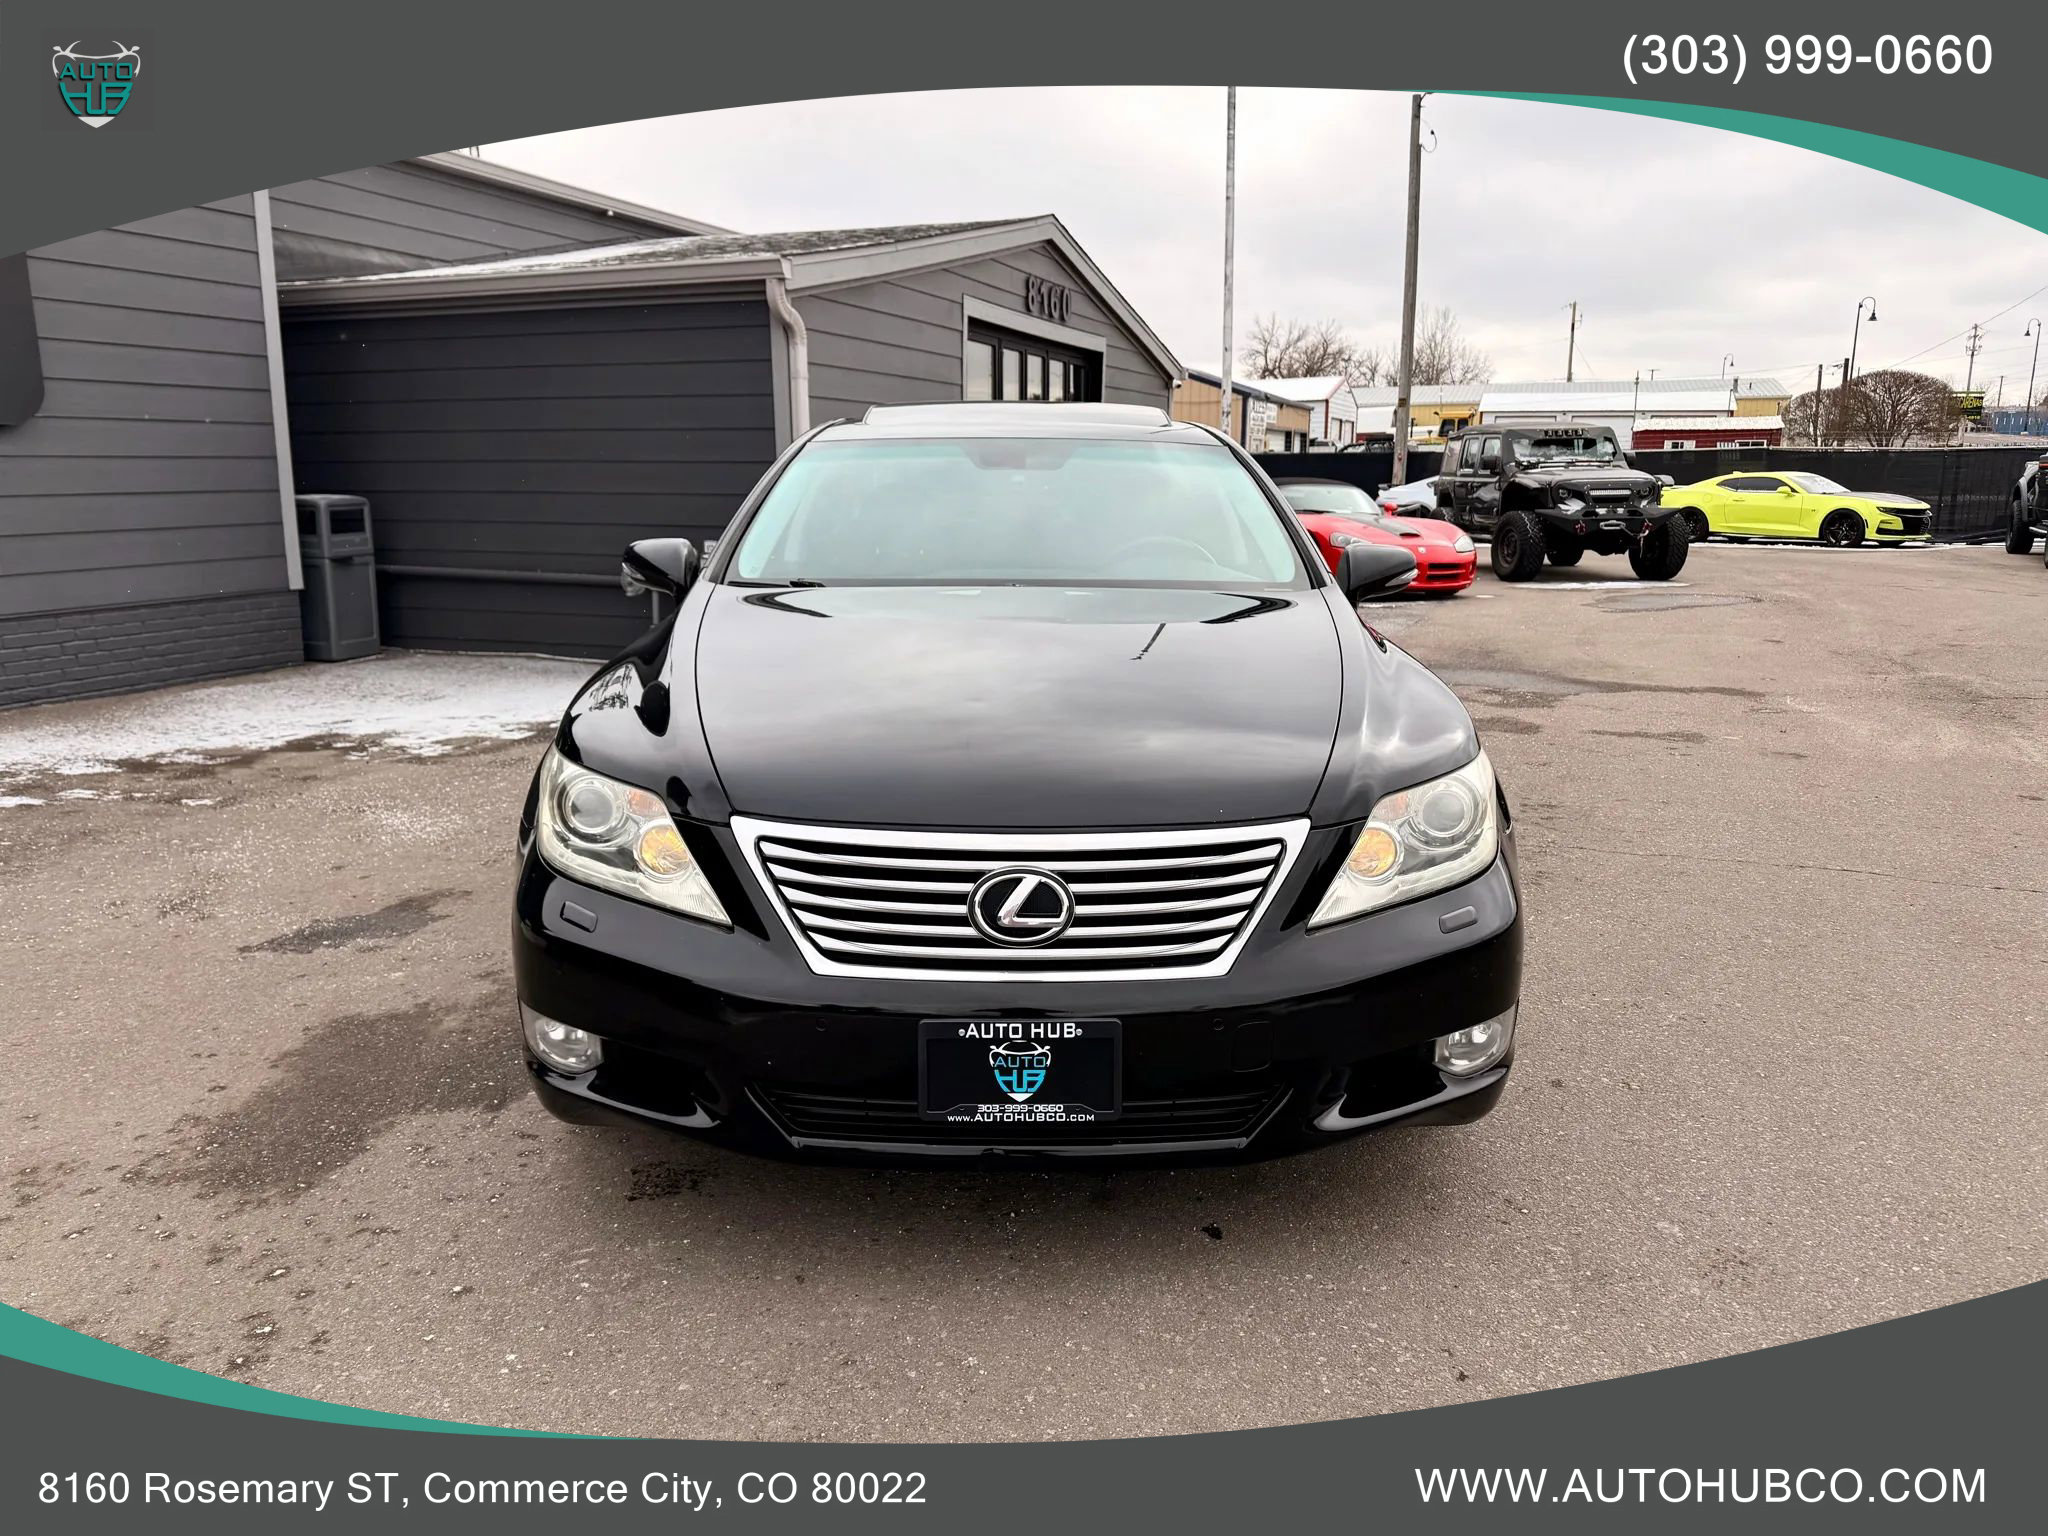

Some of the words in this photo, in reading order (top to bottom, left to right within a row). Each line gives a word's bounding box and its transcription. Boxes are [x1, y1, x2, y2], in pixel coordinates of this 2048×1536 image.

[1027, 275, 1071, 322] 8160
[965, 1022, 1023, 1039] AUTO
[1031, 1023, 1076, 1039] HUB
[994, 1056, 1046, 1068] AUTO
[994, 1069, 1047, 1093] HUB
[977, 1104, 1064, 1113] 303-999-0660
